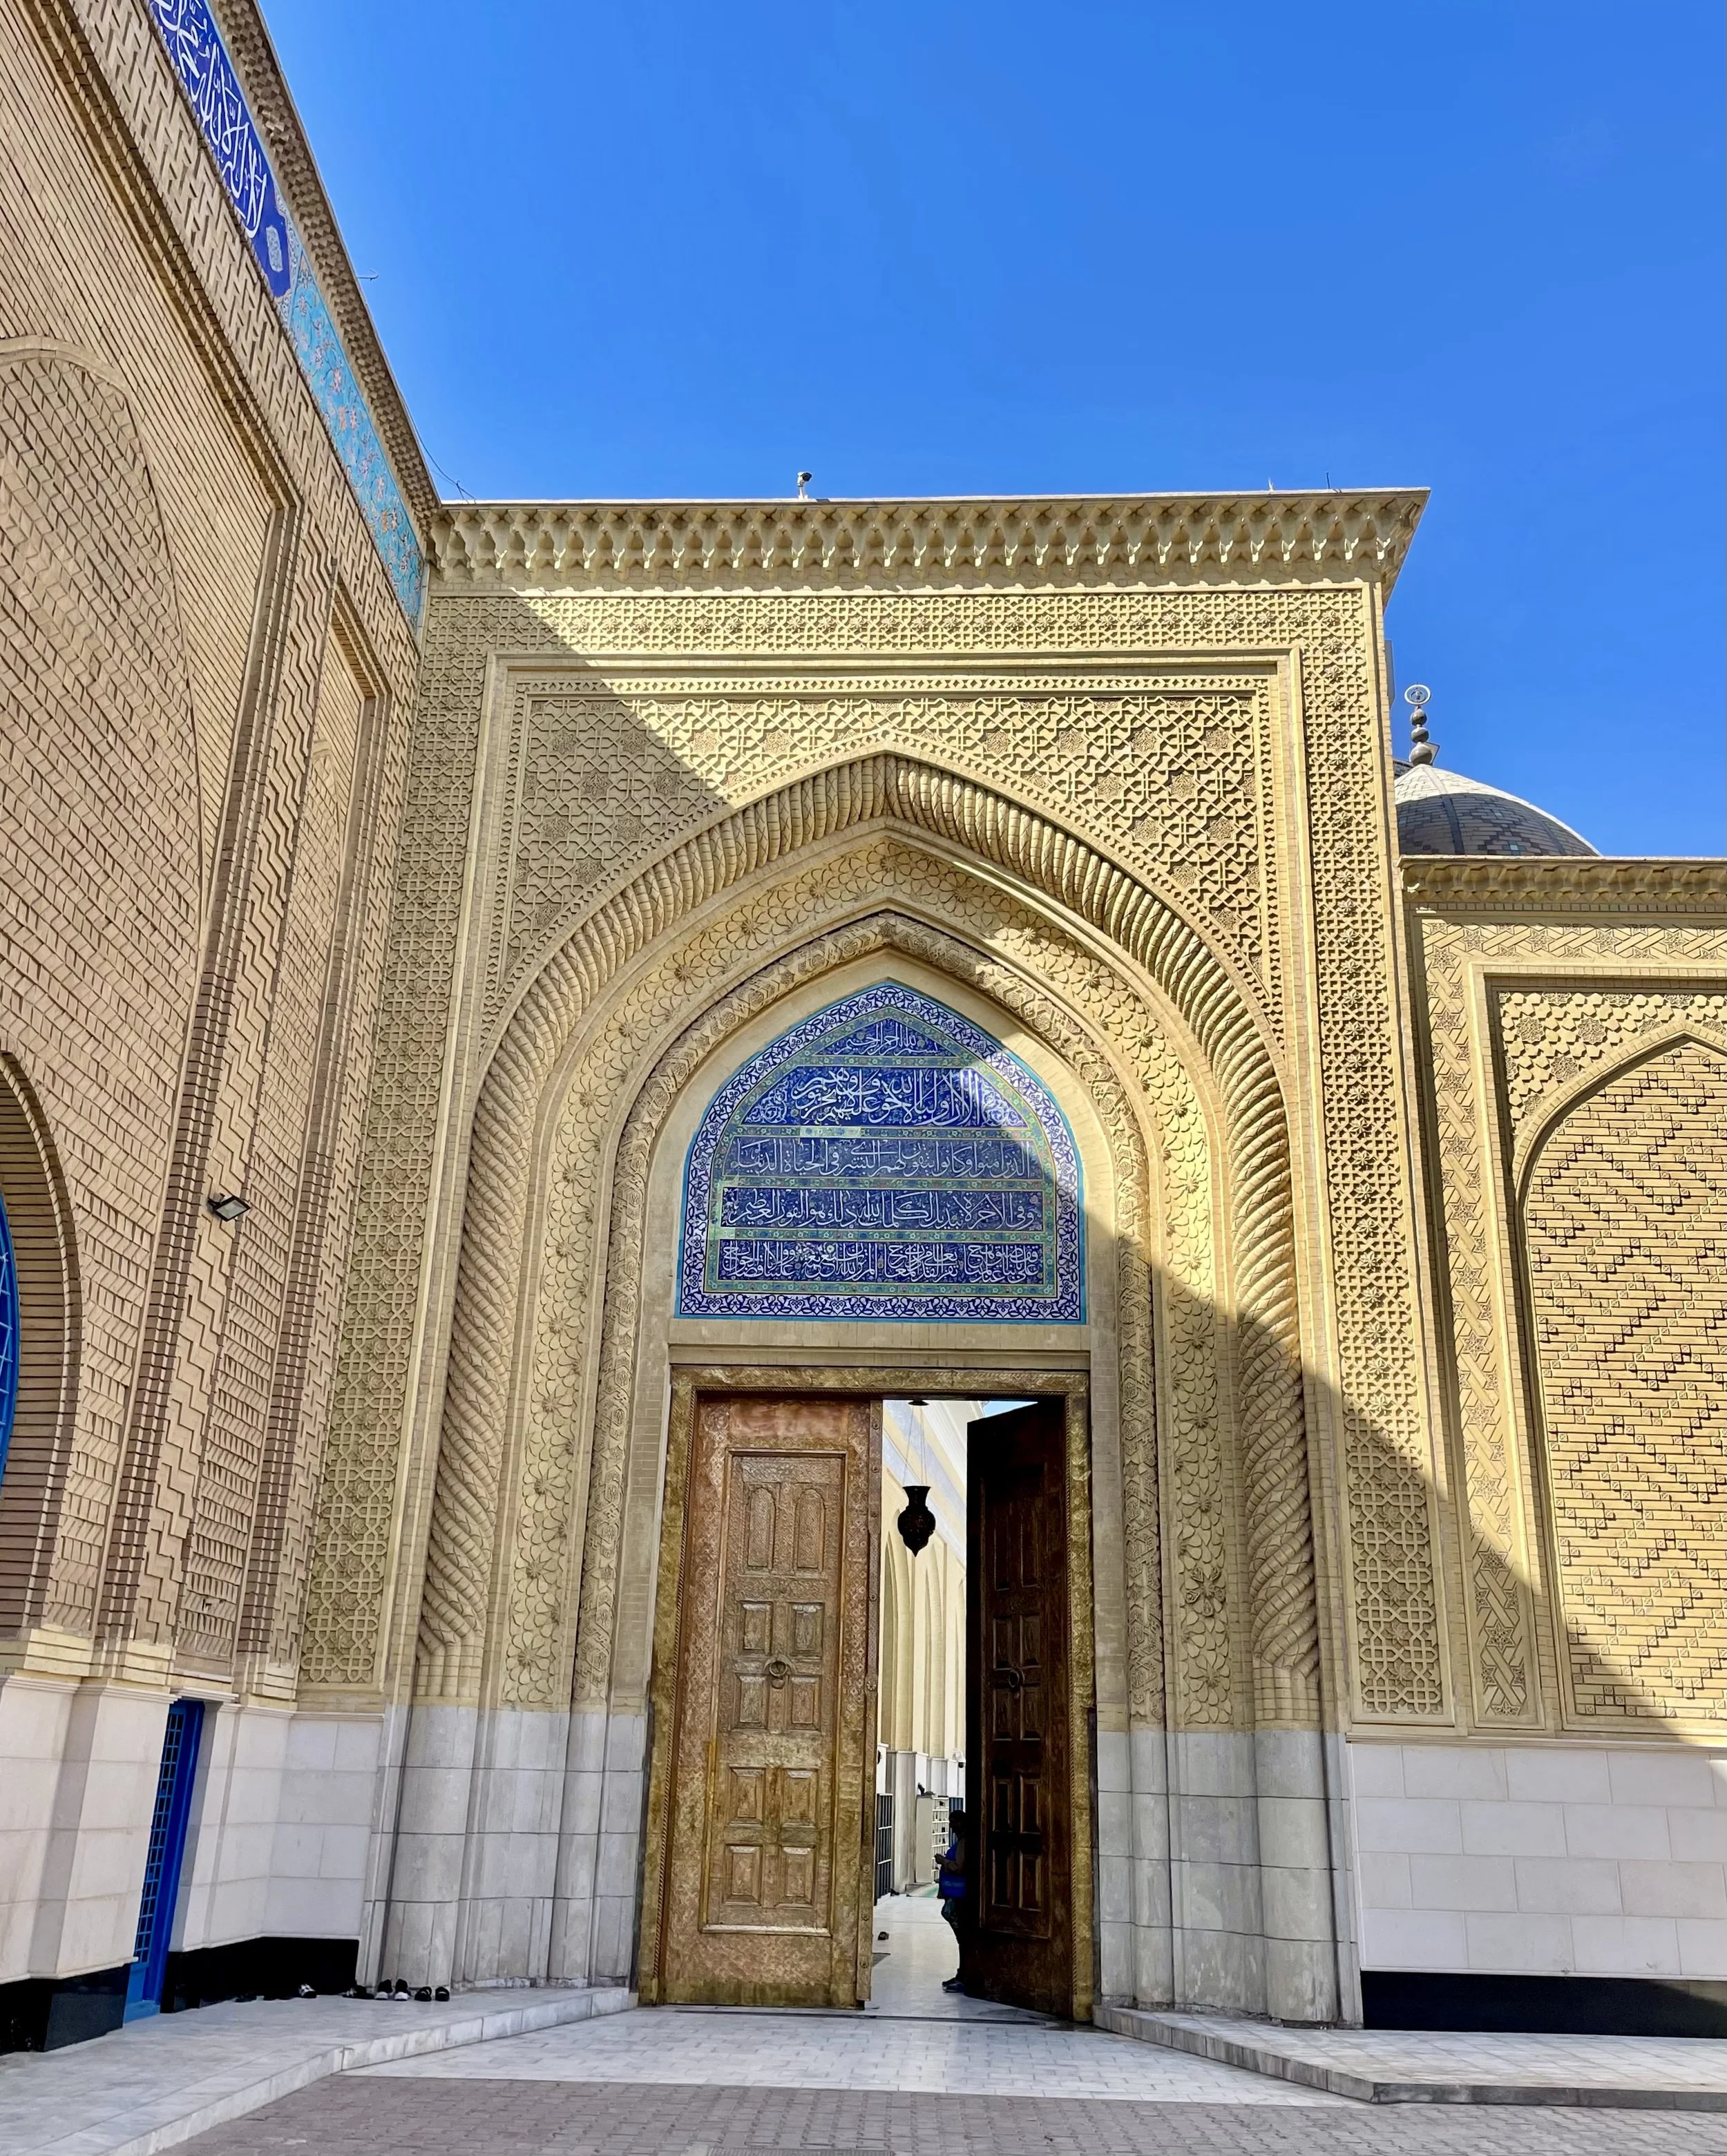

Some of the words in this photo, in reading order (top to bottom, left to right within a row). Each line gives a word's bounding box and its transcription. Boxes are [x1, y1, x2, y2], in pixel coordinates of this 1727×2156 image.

[737, 1138, 783, 1175] الدنيا
[869, 1139, 906, 1178] لهم
[901, 1141, 935, 1178] يتقون
[932, 1140, 973, 1178] وكانوا
[990, 1140, 1031, 1179] الذين
[728, 1188, 781, 1225] العظيم
[764, 1190, 810, 1228] الفوز
[796, 1203, 826, 1228] هو
[816, 1190, 857, 1229] ذلك
[861, 1190, 880, 1221] الله
[919, 1192, 965, 1230] تبديل
